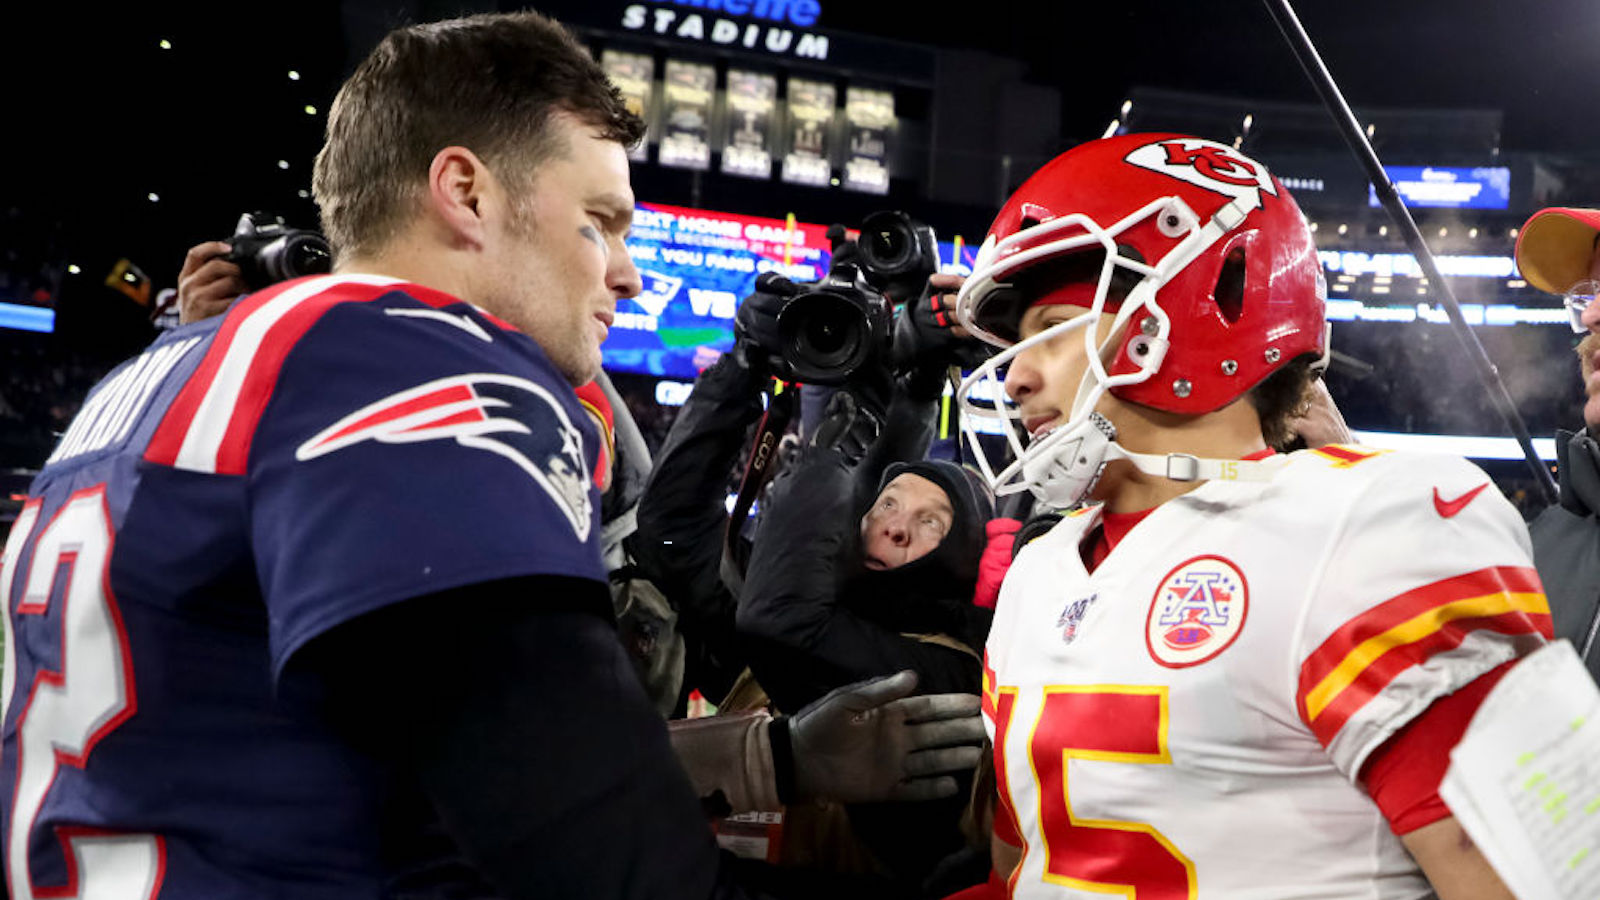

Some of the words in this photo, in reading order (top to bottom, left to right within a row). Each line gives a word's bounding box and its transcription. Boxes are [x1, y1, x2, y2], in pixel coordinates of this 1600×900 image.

[621, 5, 830, 60] STADIUM
[1158, 143, 1261, 187] KC
[632, 208, 676, 229] EXT
[677, 215, 743, 239] HOME
[744, 224, 806, 246] GAME
[660, 248, 704, 267] YOU
[705, 252, 755, 273] FANS
[1220, 462, 1239, 480] 15
[1159, 573, 1229, 626] A
[993, 684, 1198, 900] 15
